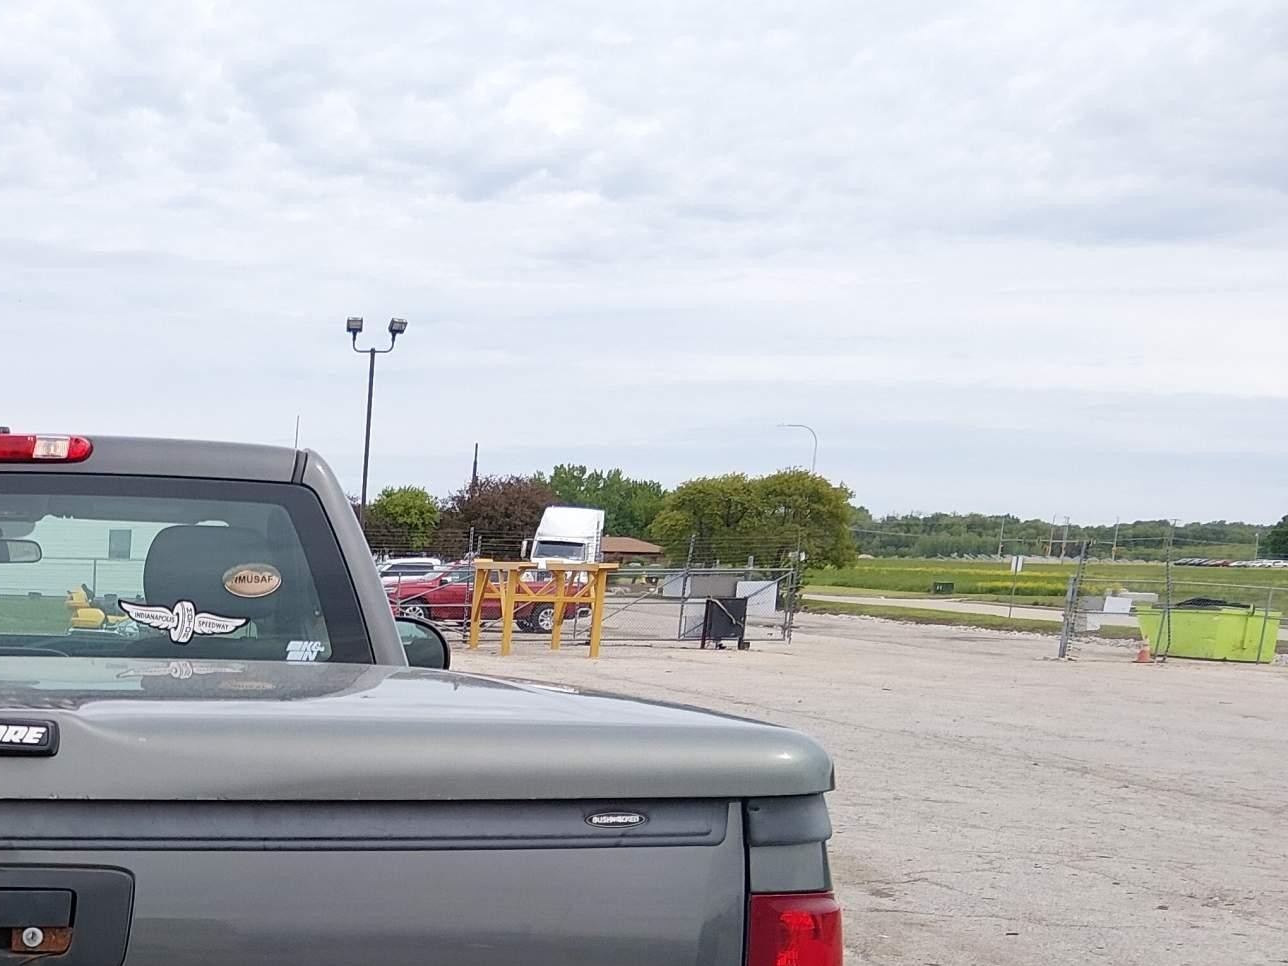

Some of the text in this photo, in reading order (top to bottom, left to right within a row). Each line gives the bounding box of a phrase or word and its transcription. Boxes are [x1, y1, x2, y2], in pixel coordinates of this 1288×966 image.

[134, 611, 175, 624] INDIANAPOLIS
[183, 607, 193, 639] MOTOR
[198, 620, 230, 631] SPEEDWAY
